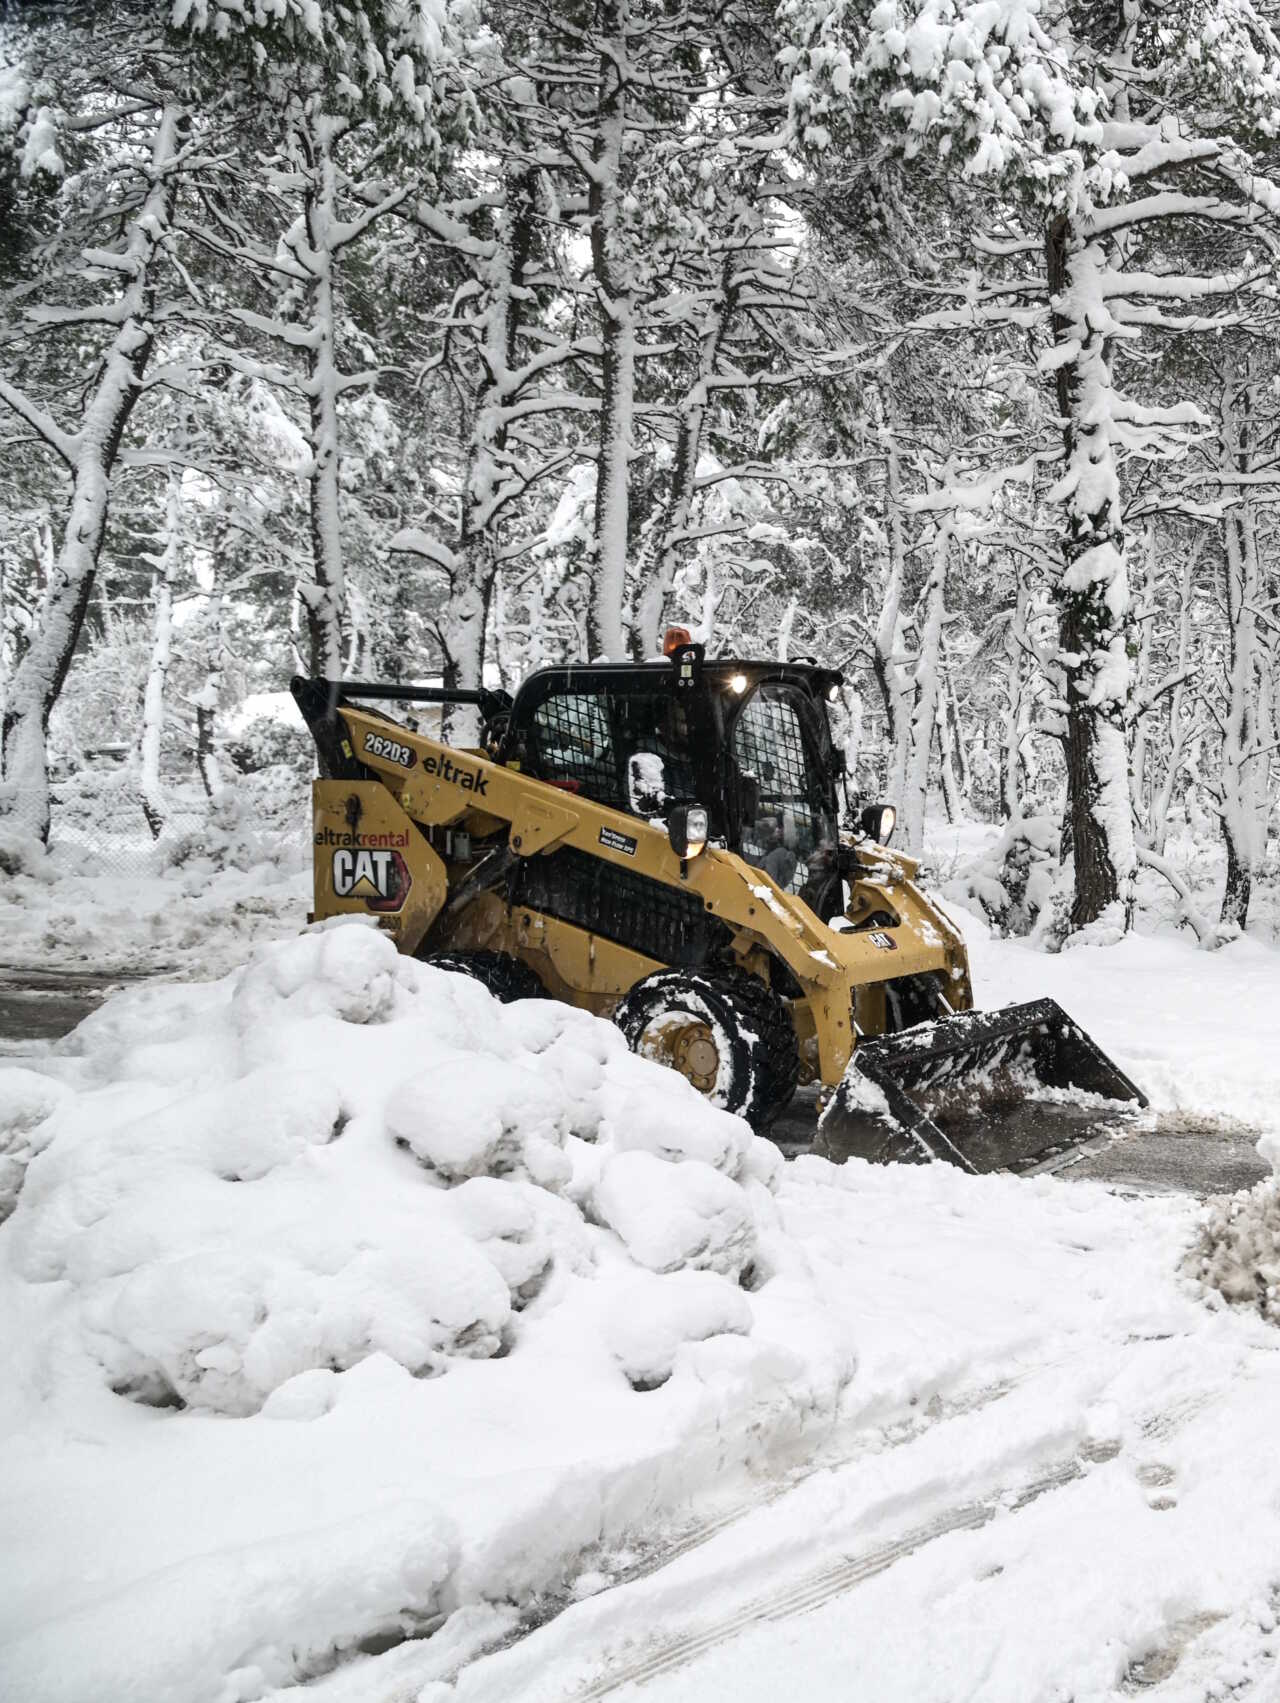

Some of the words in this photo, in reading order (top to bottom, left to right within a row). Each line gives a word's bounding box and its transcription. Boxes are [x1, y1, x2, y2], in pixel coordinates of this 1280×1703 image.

[364, 732, 411, 766] 262D3
[422, 753, 489, 796] eltrak
[314, 827, 409, 847] eltrakrental
[333, 849, 392, 897] CAT
